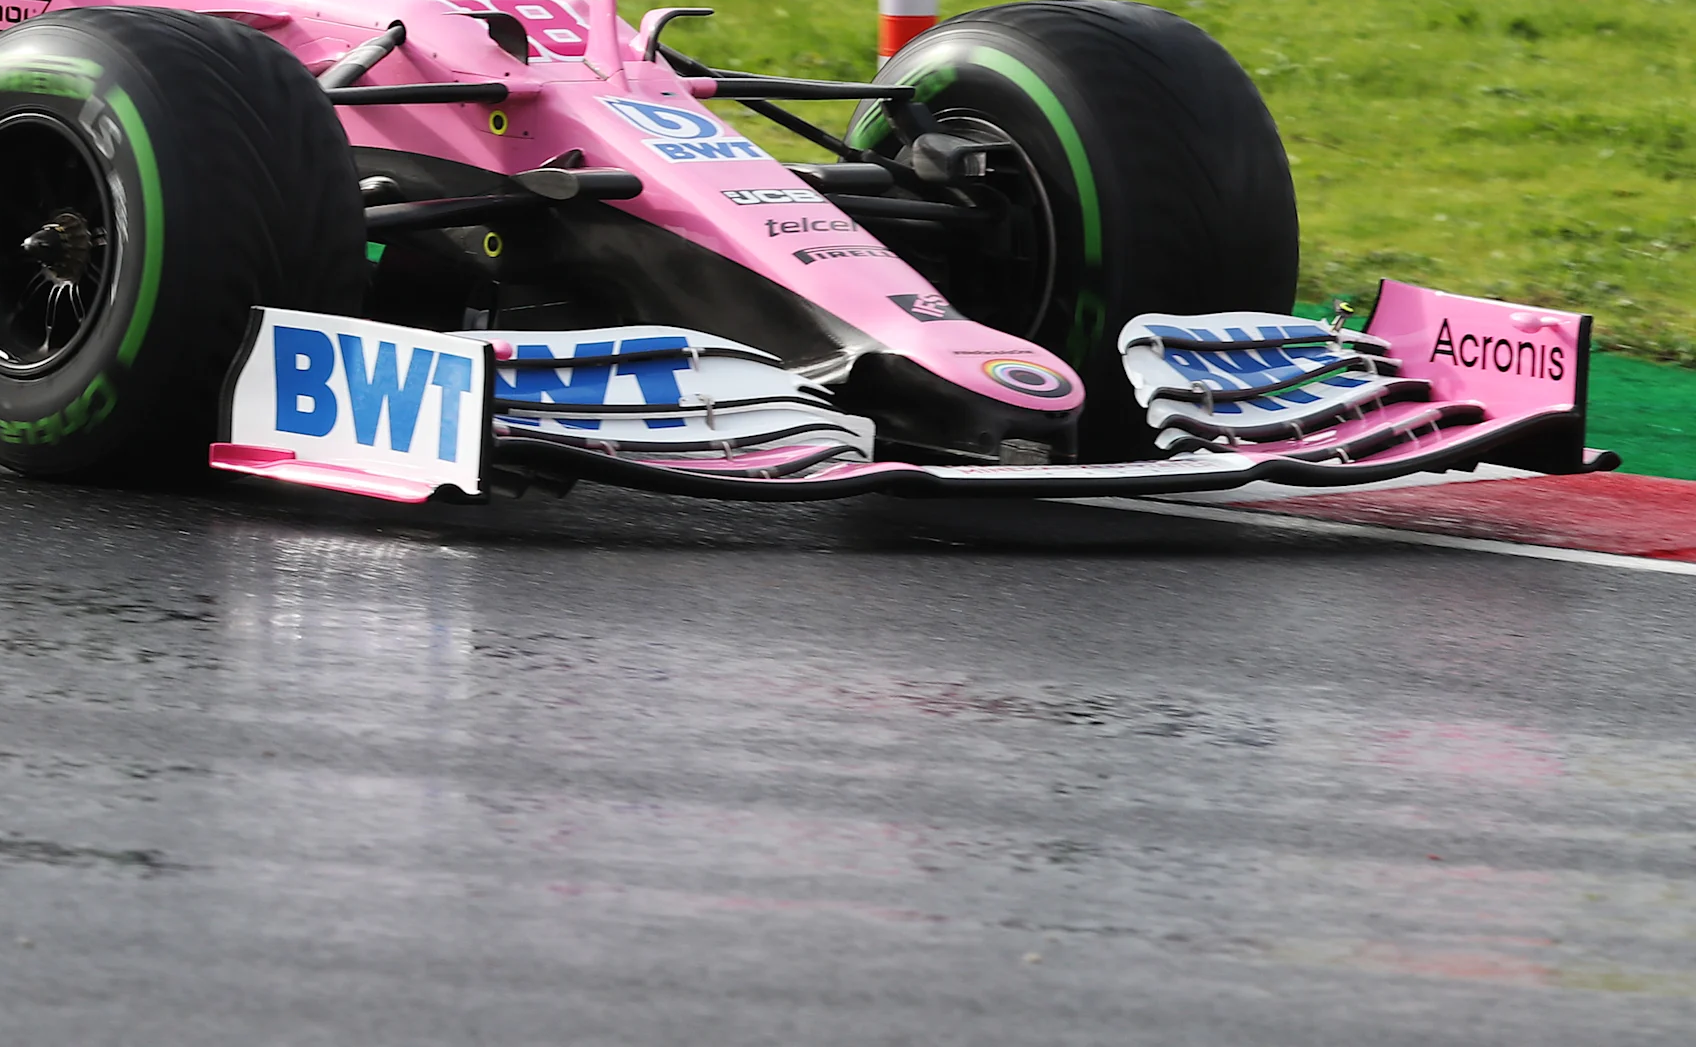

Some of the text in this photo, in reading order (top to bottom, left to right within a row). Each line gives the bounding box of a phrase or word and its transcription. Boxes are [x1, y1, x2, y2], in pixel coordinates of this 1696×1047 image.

[654, 141, 763, 160] BWT
[731, 189, 825, 205] JCB
[764, 217, 859, 237] telcel
[792, 245, 899, 265] PIRELL
[1430, 318, 1565, 381] Acronis
[494, 336, 691, 430] WT
[273, 325, 473, 464] BWT
